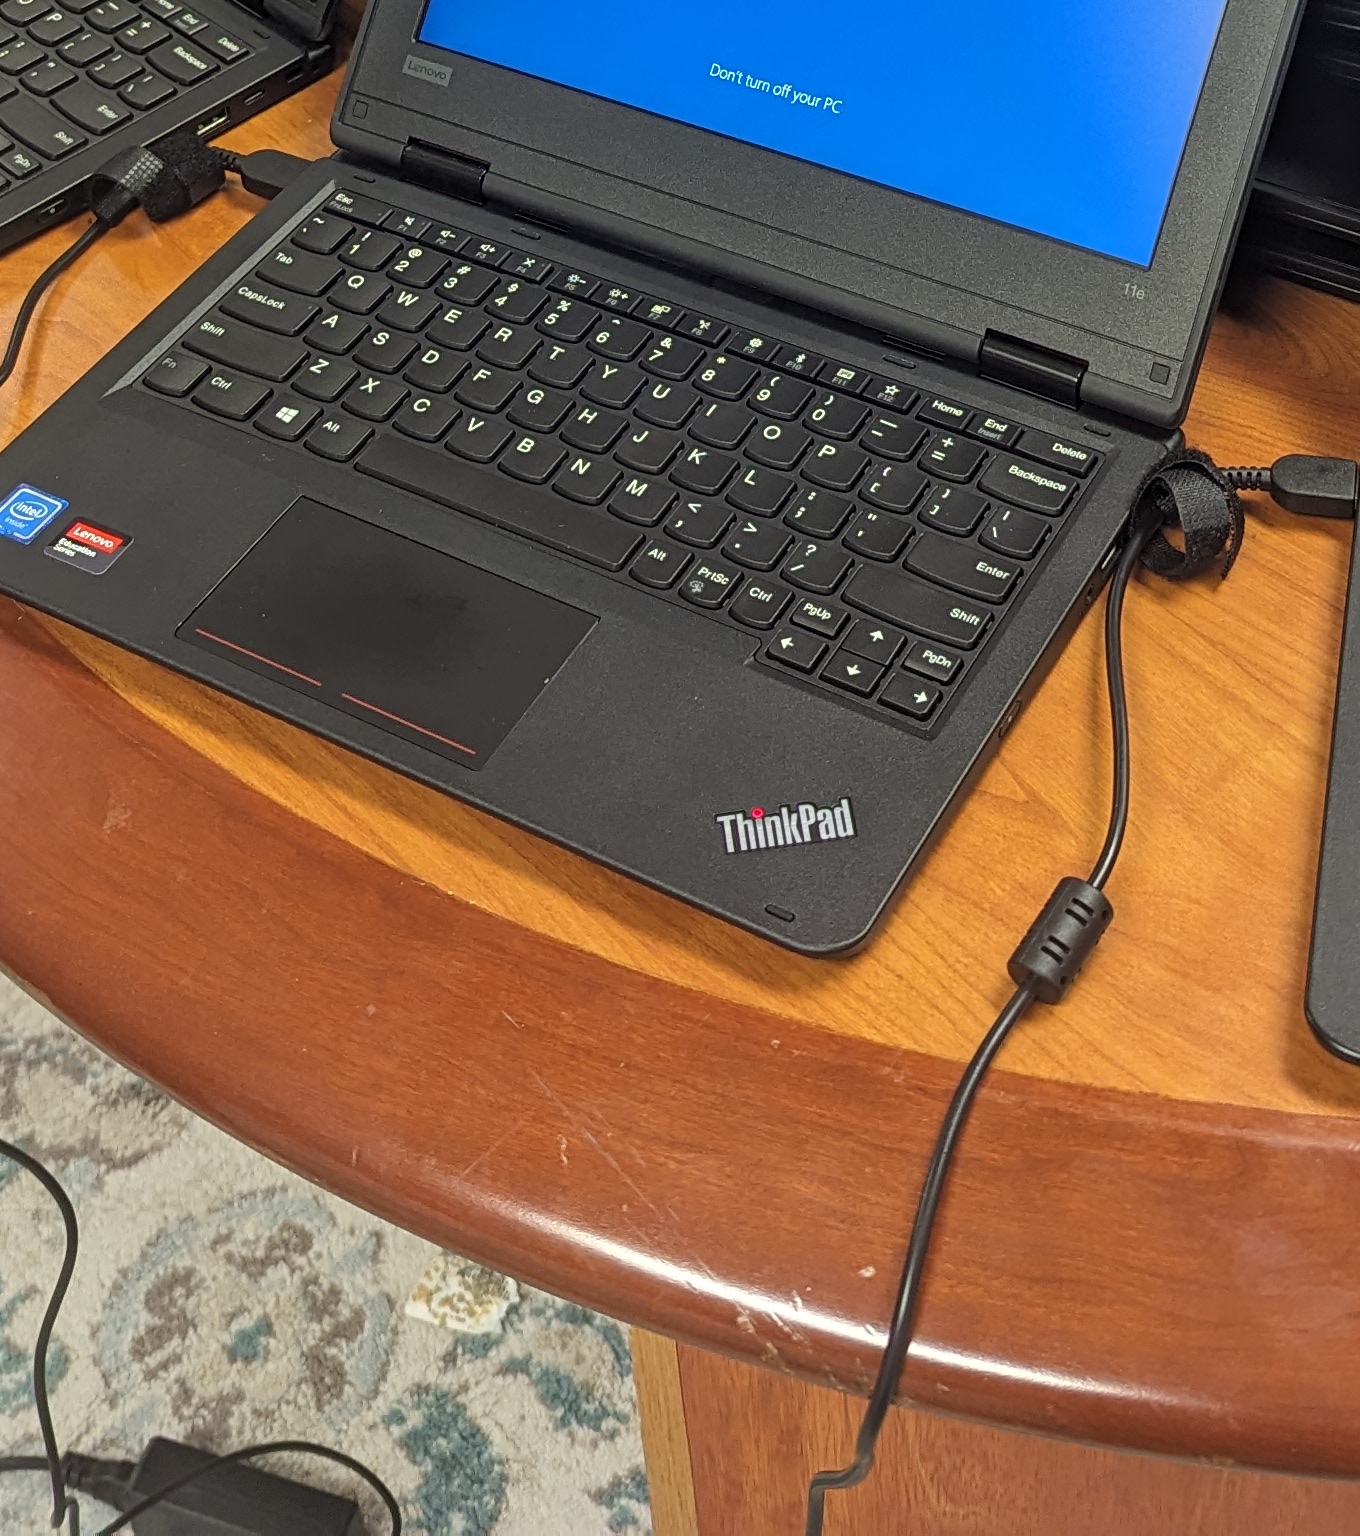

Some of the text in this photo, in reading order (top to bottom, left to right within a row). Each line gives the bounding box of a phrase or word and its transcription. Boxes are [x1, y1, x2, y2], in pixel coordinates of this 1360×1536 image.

[407, 59, 447, 80] Lenovo
[709, 62, 843, 114] Don't turn off your PC
[333, 193, 354, 207] Esc
[349, 244, 361, 255] 1
[275, 252, 293, 265] Tab
[393, 260, 410, 272] 2
[347, 275, 365, 289] Q
[443, 277, 458, 289] 3
[237, 286, 286, 310] CapsLock
[397, 291, 420, 307] W
[1124, 282, 1145, 300] 11e
[494, 295, 508, 307] 4
[321, 314, 339, 328] A
[443, 309, 463, 324] E
[544, 312, 560, 325] 5
[200, 321, 225, 337] Shift
[493, 327, 513, 343] R
[372, 332, 390, 345] S
[595, 331, 610, 344] 6
[421, 349, 440, 364] D
[549, 345, 566, 360] T
[648, 349, 664, 361] 7
[161, 357, 177, 369] Fn
[309, 358, 330, 374] Z
[472, 368, 492, 381] F
[602, 364, 618, 379] Y
[701, 369, 716, 382] 8
[211, 376, 233, 390] Ctrl
[359, 377, 381, 394] X
[652, 383, 671, 399] U
[526, 389, 545, 405] G
[756, 388, 771, 401] 9
[413, 398, 431, 413] C
[931, 399, 964, 417] Home
[577, 408, 598, 424] H
[322, 420, 340, 433] Alt
[467, 417, 485, 432] V
[982, 418, 1008, 435] End
[632, 430, 649, 443] J
[977, 427, 1002, 441] Insert
[516, 437, 535, 453] B
[817, 444, 836, 457] P
[1052, 442, 1087, 460] Delete
[687, 448, 708, 465] K
[570, 458, 591, 475] N
[743, 469, 756, 486] L
[1008, 464, 1067, 492] Backspace
[625, 479, 648, 497] M
[15, 500, 43, 520] intel
[72, 526, 115, 549] Lenovo
[52, 543, 77, 558] Series
[58, 537, 97, 558] Education
[647, 548, 667, 562] Alt
[697, 566, 730, 588] PrtSc
[975, 561, 1011, 580] Enter
[749, 587, 773, 603] Ctrl
[802, 602, 832, 620] PgUp
[949, 607, 980, 626] Shift
[922, 649, 952, 668] PgDn
[716, 798, 856, 854] ThinkPad
